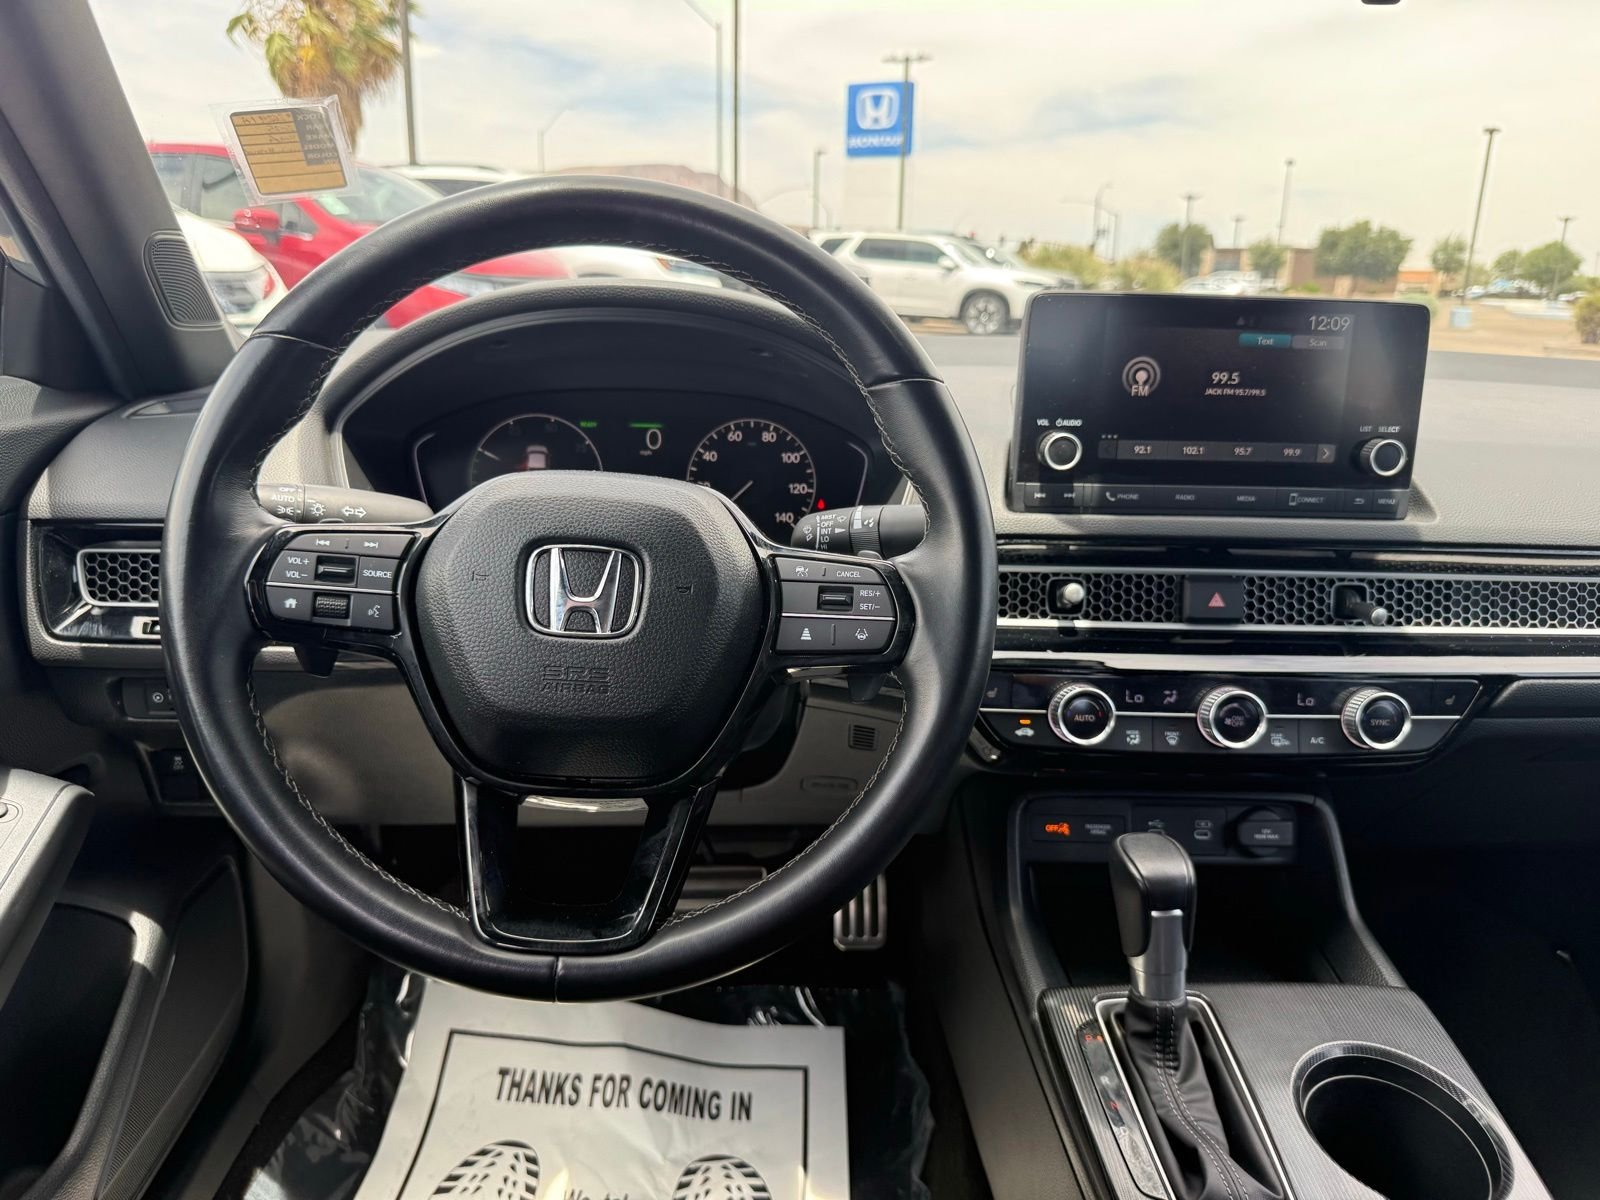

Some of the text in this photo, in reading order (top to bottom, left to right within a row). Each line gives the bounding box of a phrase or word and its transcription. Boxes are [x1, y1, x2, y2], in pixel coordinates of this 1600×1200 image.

[1308, 315, 1350, 331] 12:09
[1256, 337, 1274, 346] Text
[1211, 371, 1240, 385] 99.5
[1131, 385, 1149, 397] FM
[1204, 387, 1222, 396] JACK
[1223, 388, 1234, 396] FM
[1036, 418, 1083, 427] VOL AUDIO
[1359, 425, 1401, 433] LIST SELECT
[645, 428, 662, 450] 0
[727, 431, 743, 442] 60
[761, 431, 777, 443] 80
[1134, 445, 1152, 454] 92.1
[1182, 446, 1205, 455] 102.1
[1233, 447, 1253, 456] 95.7
[1283, 448, 1301, 457] 99.9
[702, 451, 718, 462] 40
[781, 452, 800, 463] 100
[788, 483, 808, 494] 120
[271, 494, 296, 503] AUTO
[1298, 496, 1324, 504] CONNECT
[1377, 497, 1396, 505] MENU
[774, 512, 794, 523] 140
[363, 569, 392, 579] SOURCE
[836, 570, 861, 578] CANCEL
[543, 665, 610, 681] SRS
[1125, 689, 1144, 703] Lo
[1073, 714, 1095, 722] AUTO
[1309, 736, 1325, 745] A/C
[1045, 824, 1059, 833] OFF
[497, 1066, 754, 1122] THANKS FOR COMING IN
